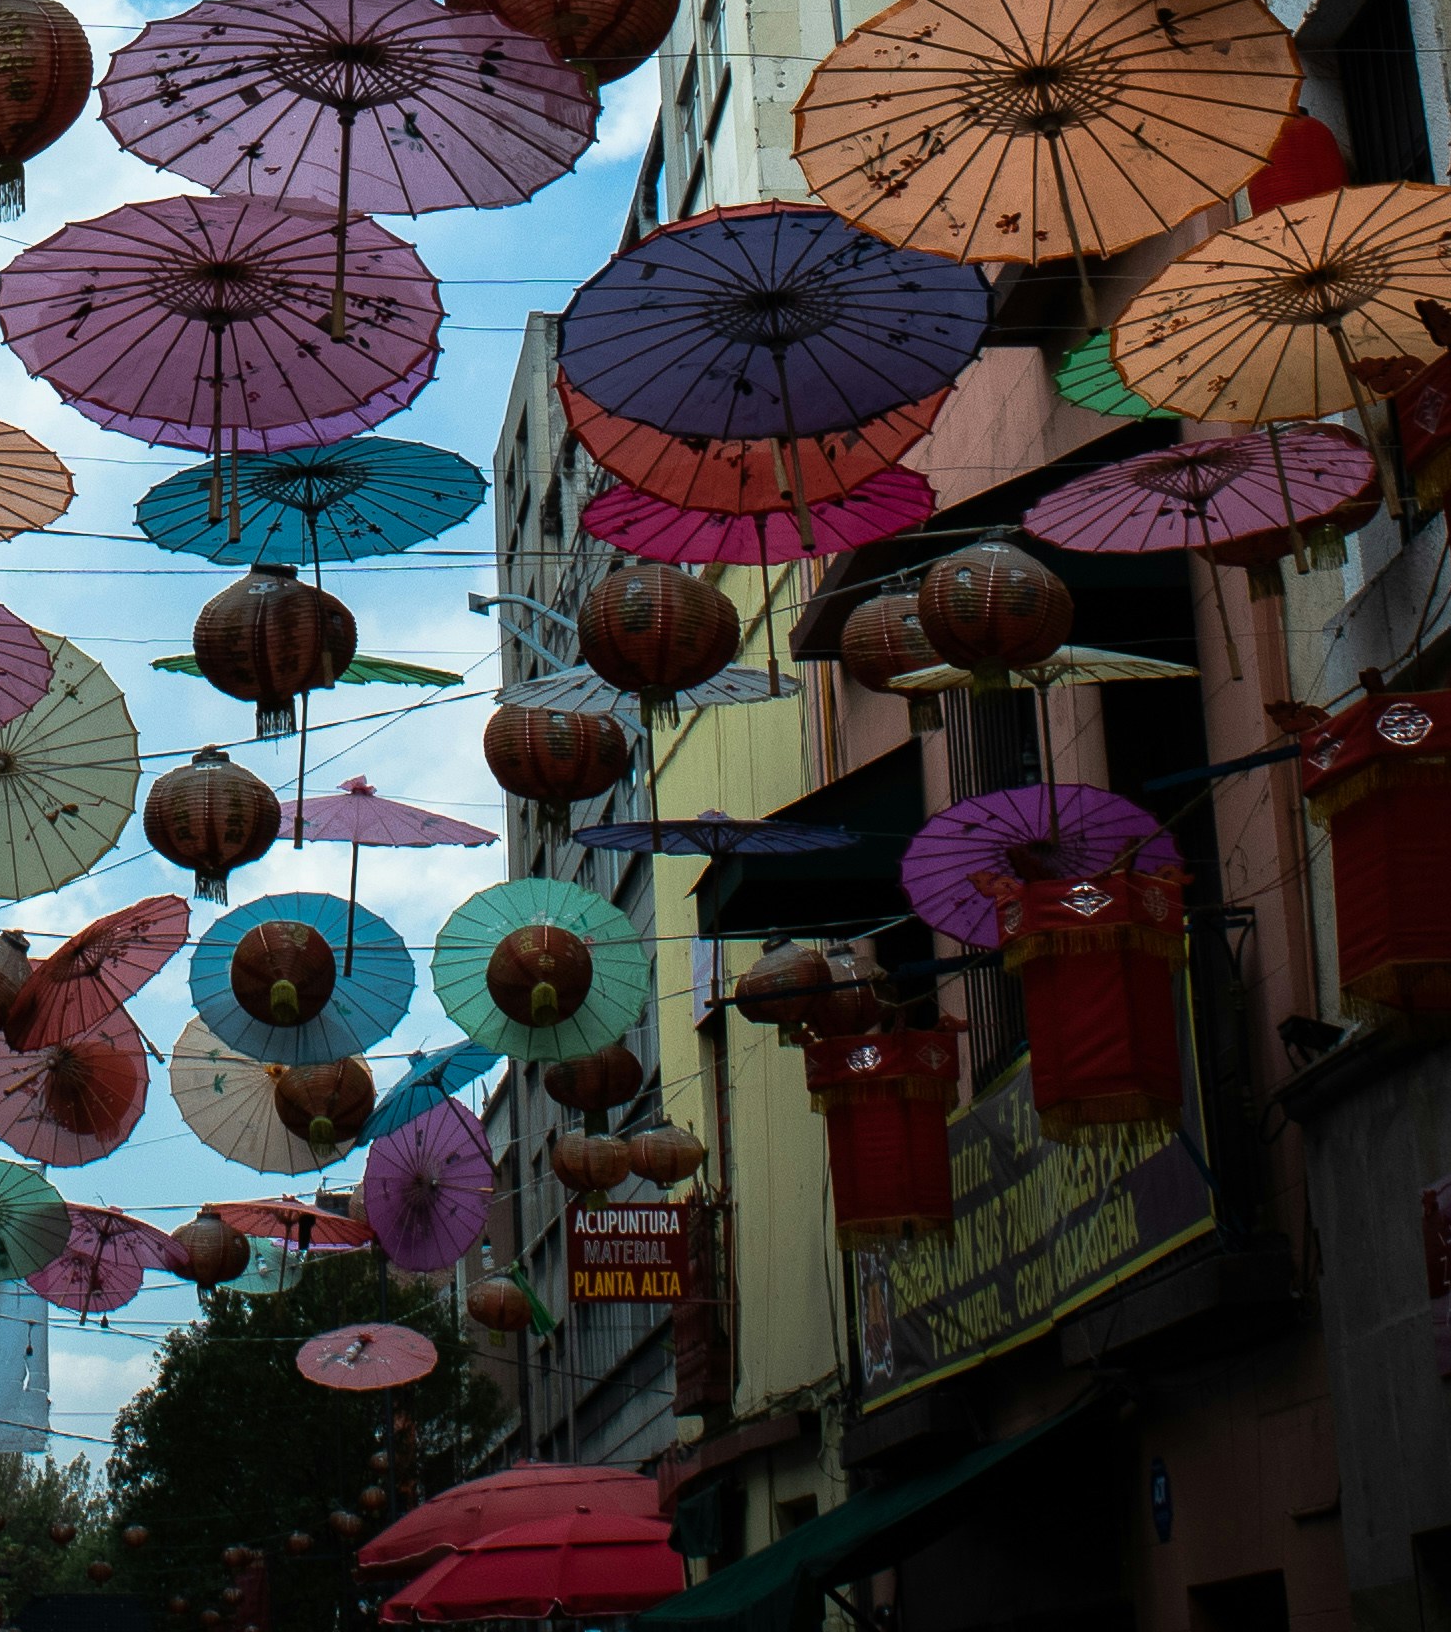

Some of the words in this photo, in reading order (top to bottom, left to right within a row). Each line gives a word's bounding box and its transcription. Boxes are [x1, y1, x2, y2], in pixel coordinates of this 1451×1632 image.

[574, 1209, 680, 1234] ACUPUNTURA
[975, 1196, 1003, 1275] SUS
[584, 1239, 672, 1265] MATERIAL
[574, 1270, 636, 1297] PLANTA
[641, 1270, 682, 1297] ALTA
[927, 1314, 938, 1360] Y
